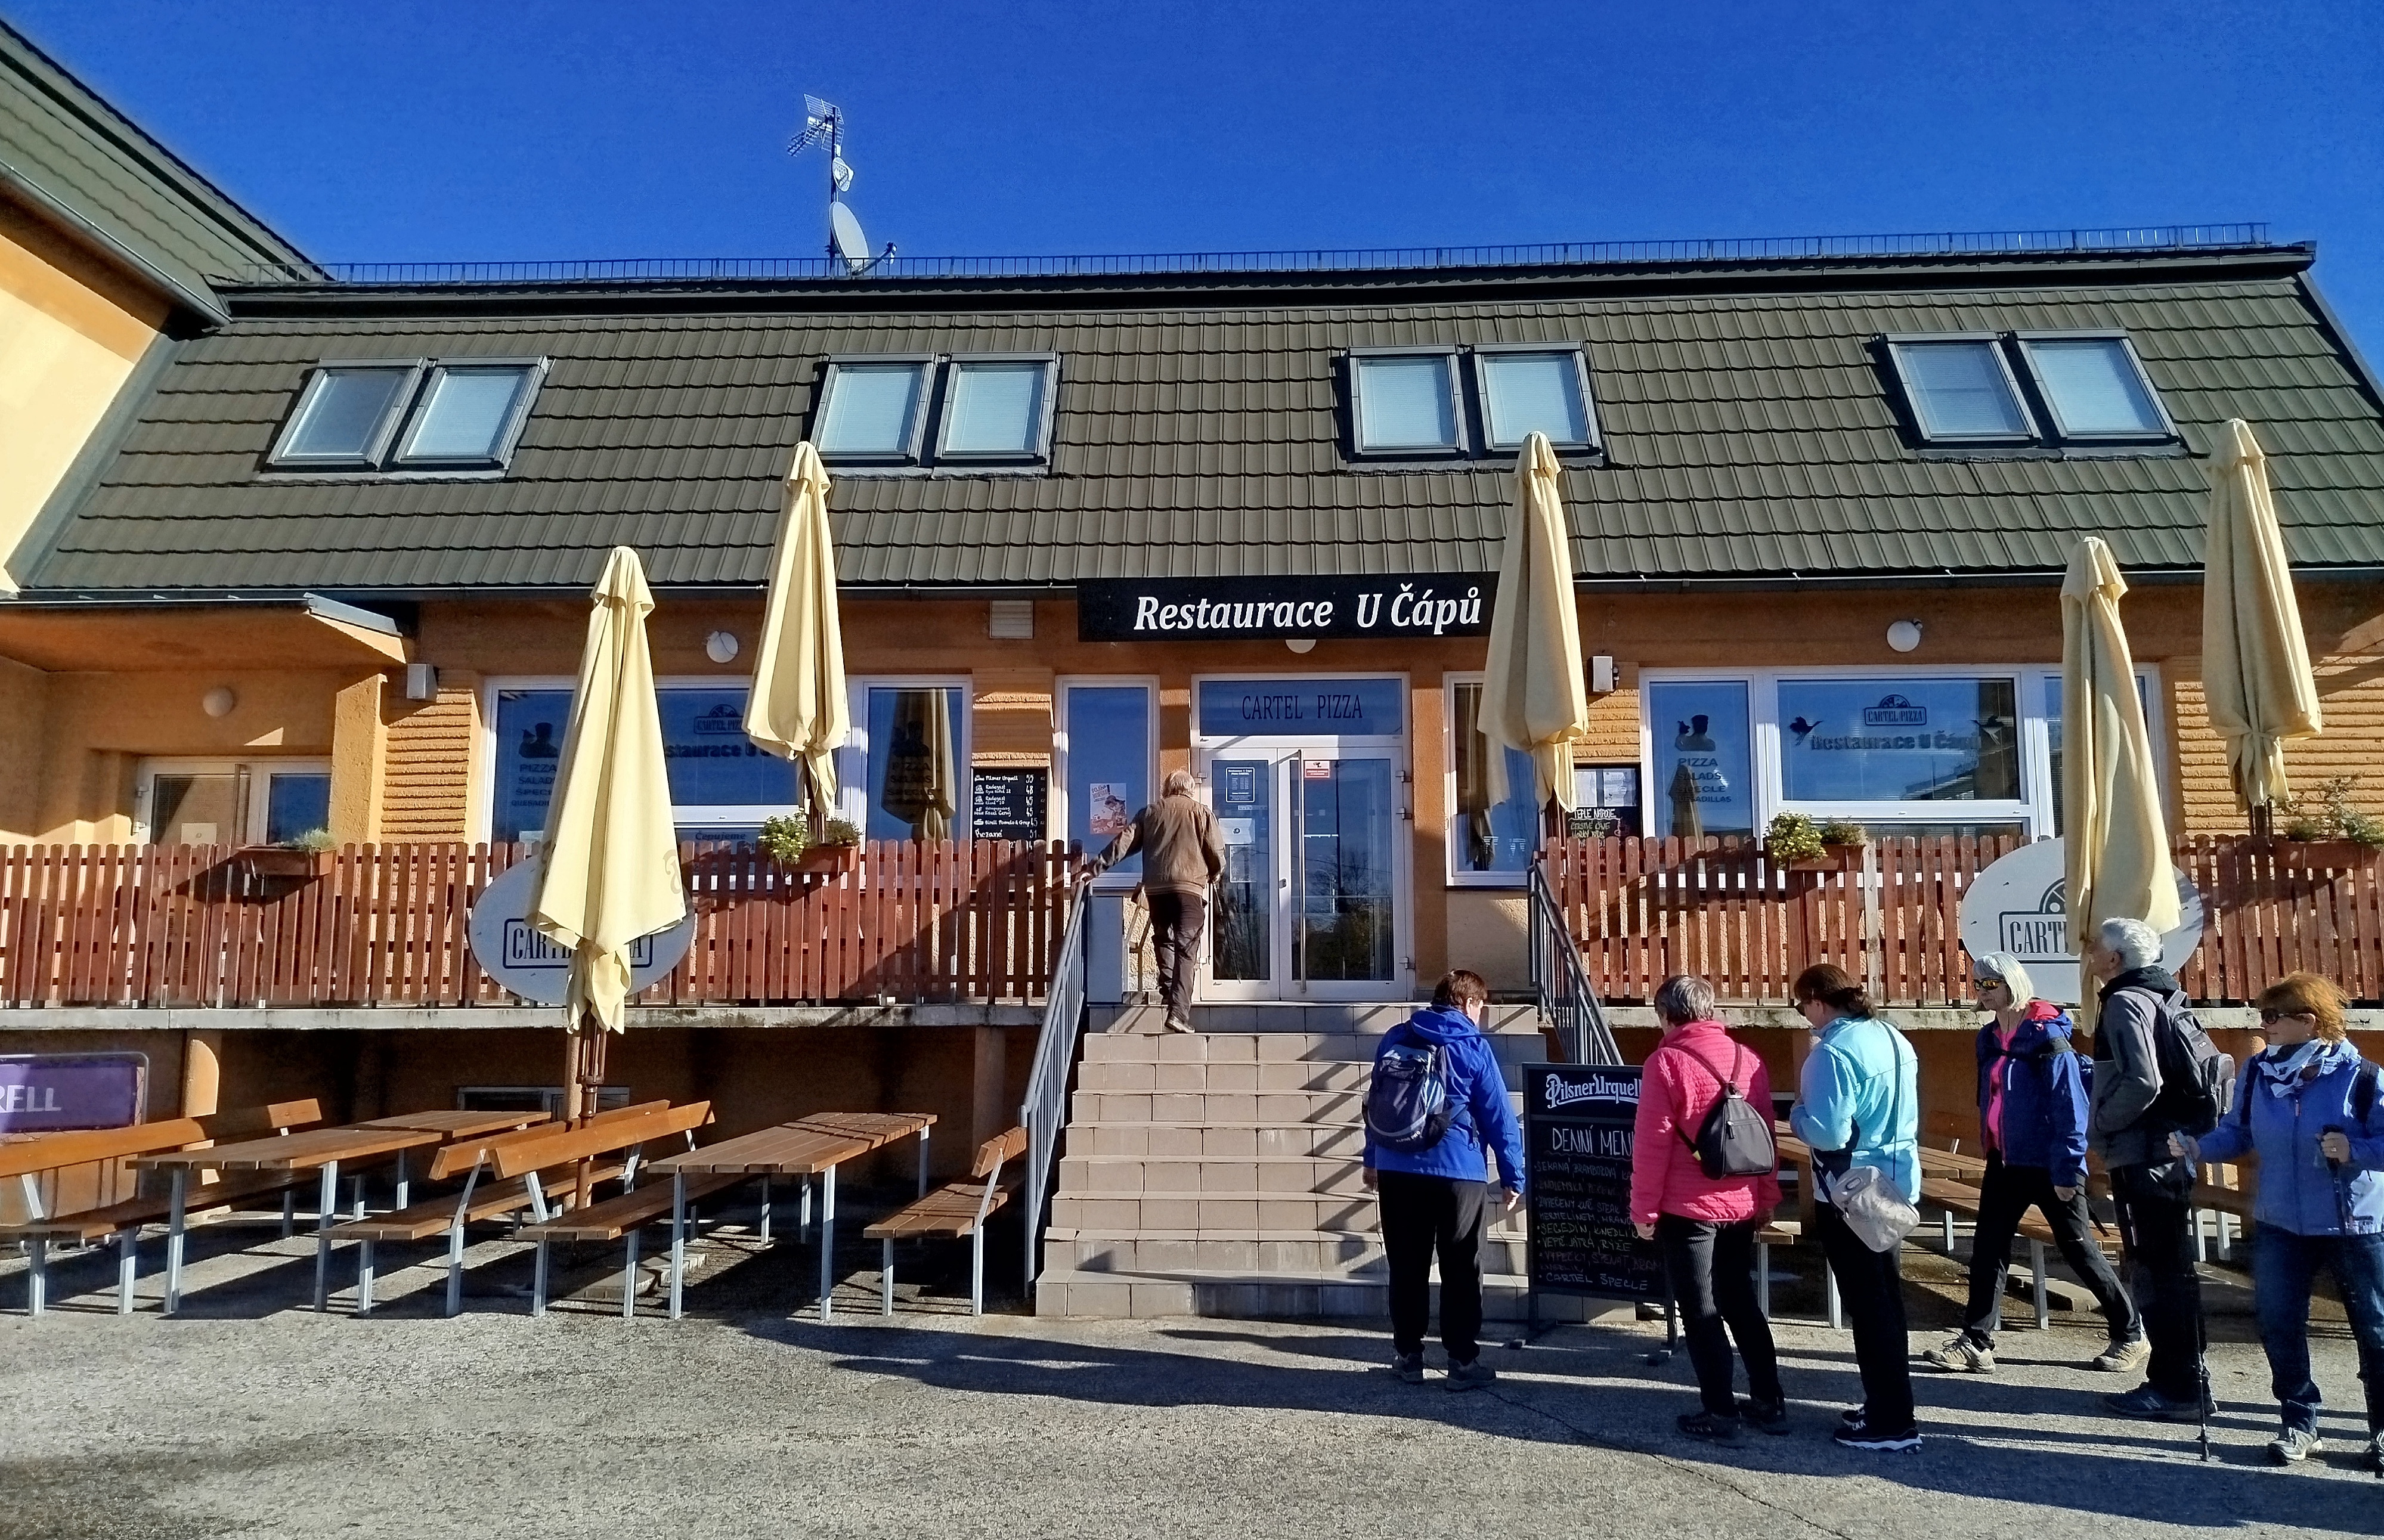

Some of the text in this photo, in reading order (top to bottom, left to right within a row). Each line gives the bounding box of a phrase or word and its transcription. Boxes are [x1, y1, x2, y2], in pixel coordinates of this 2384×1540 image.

[1134, 582, 1481, 635] Restaurace U Čápů
[1242, 695, 1363, 720] CARTEL PIZZA
[1868, 710, 1923, 722] CARTEL PIZZA
[727, 719, 742, 731] PIZZ
[1811, 734, 1915, 750] Restaurace
[1918, 733, 1931, 749] U
[665, 745, 742, 758] staurace
[519, 764, 558, 773] PIZZA
[1677, 758, 1719, 767] PIZZA
[518, 776, 556, 785] SALAD
[1026, 774, 1034, 783] 55
[1677, 771, 1722, 780] SALADS
[1026, 785, 1033, 795] 48
[1026, 796, 1033, 805] 45
[1026, 807, 1033, 817] 45
[695, 830, 745, 841] Čepujeme
[512, 928, 572, 959] CAR
[2010, 921, 2067, 954] CART
[1546, 1073, 1642, 1109] Pilsner Urquell
[1552, 1124, 1593, 1154] DENNÍ
[1596, 1203, 1620, 1214] STEAK
[1546, 1272, 1648, 1291] CARTEL ŠPECLE
